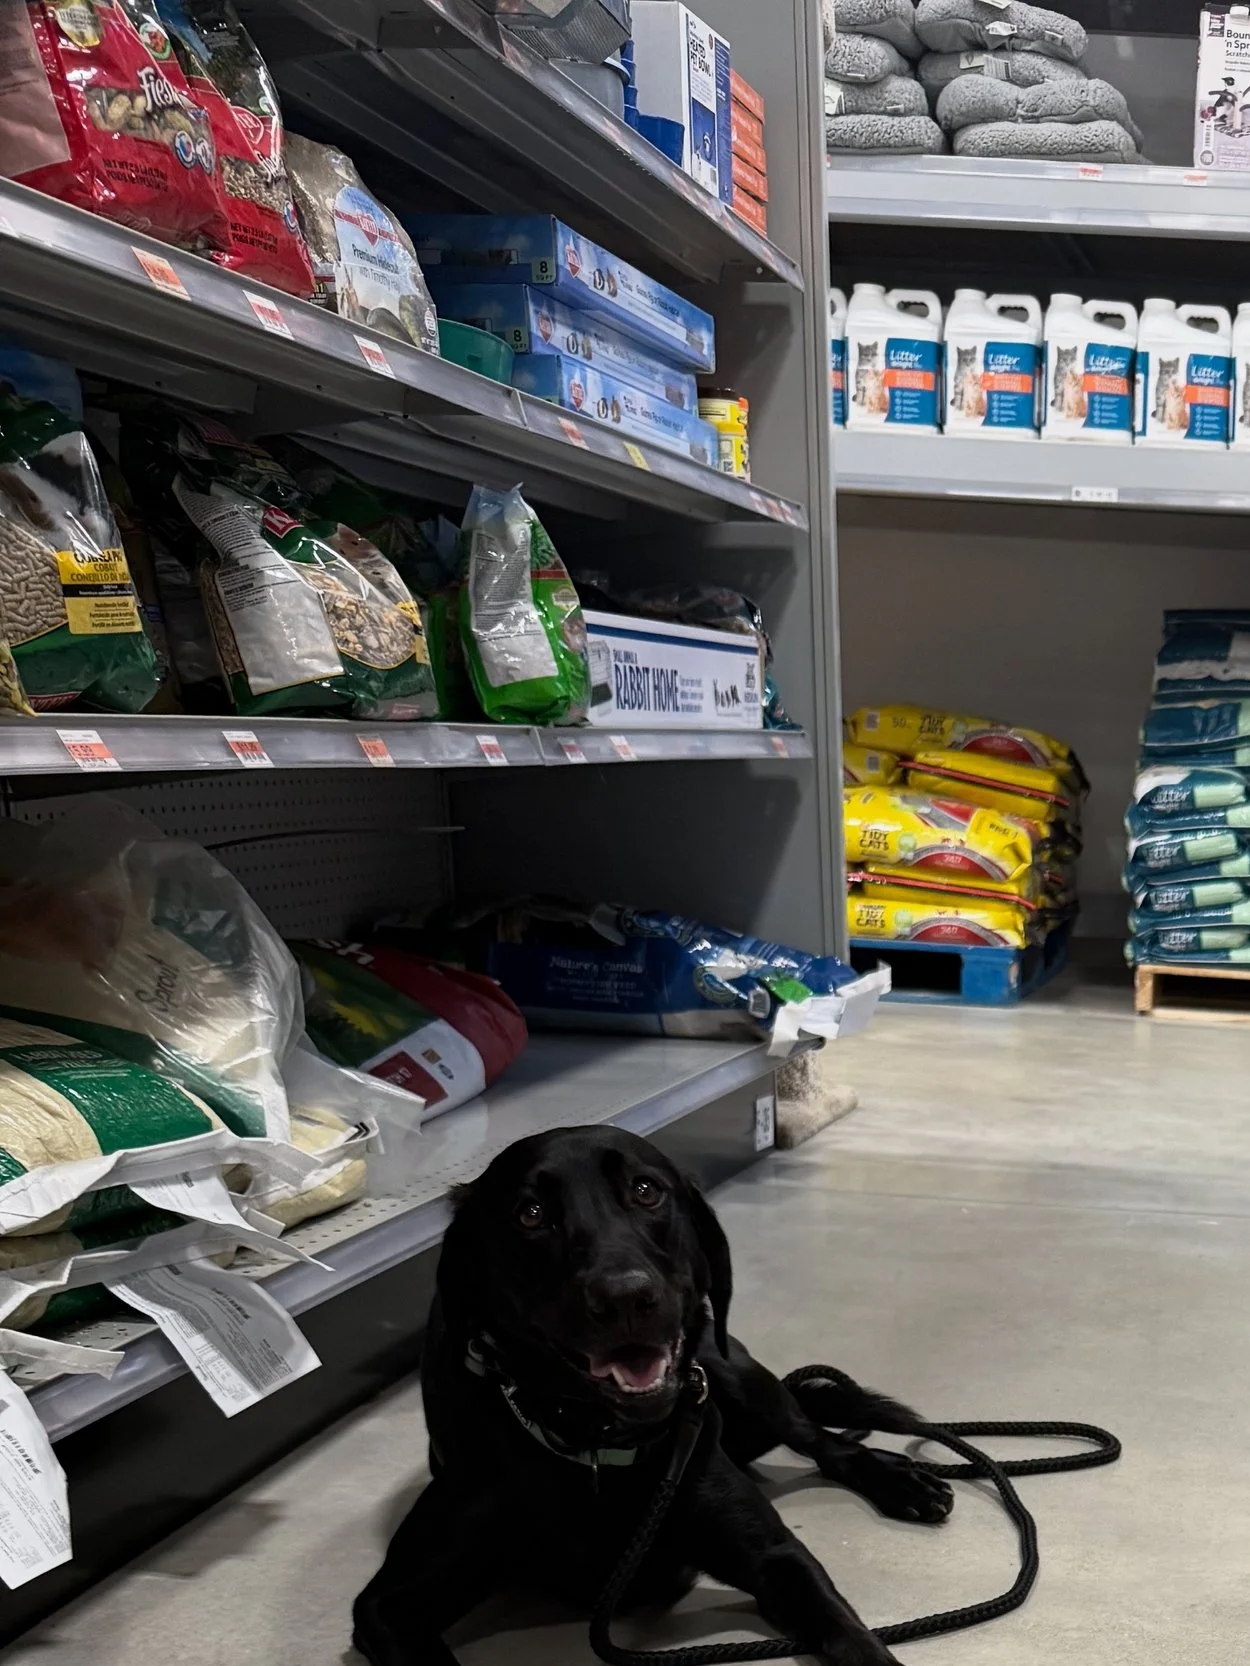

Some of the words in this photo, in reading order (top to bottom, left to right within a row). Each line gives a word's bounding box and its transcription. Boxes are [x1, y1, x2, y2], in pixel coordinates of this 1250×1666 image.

[539, 261, 548, 273] 8
[513, 330, 522, 342] 8
[890, 349, 923, 362] Litter
[988, 353, 1020, 365] Litter
[1089, 354, 1124, 366] Litter
[1191, 365, 1224, 379] Litter
[614, 664, 651, 711] RABBIT
[652, 667, 680, 713] HOME
[861, 830, 889, 841] TIDY
[859, 839, 889, 851] CATS
[858, 909, 884, 918] TIDY
[856, 917, 886, 929] CATS
